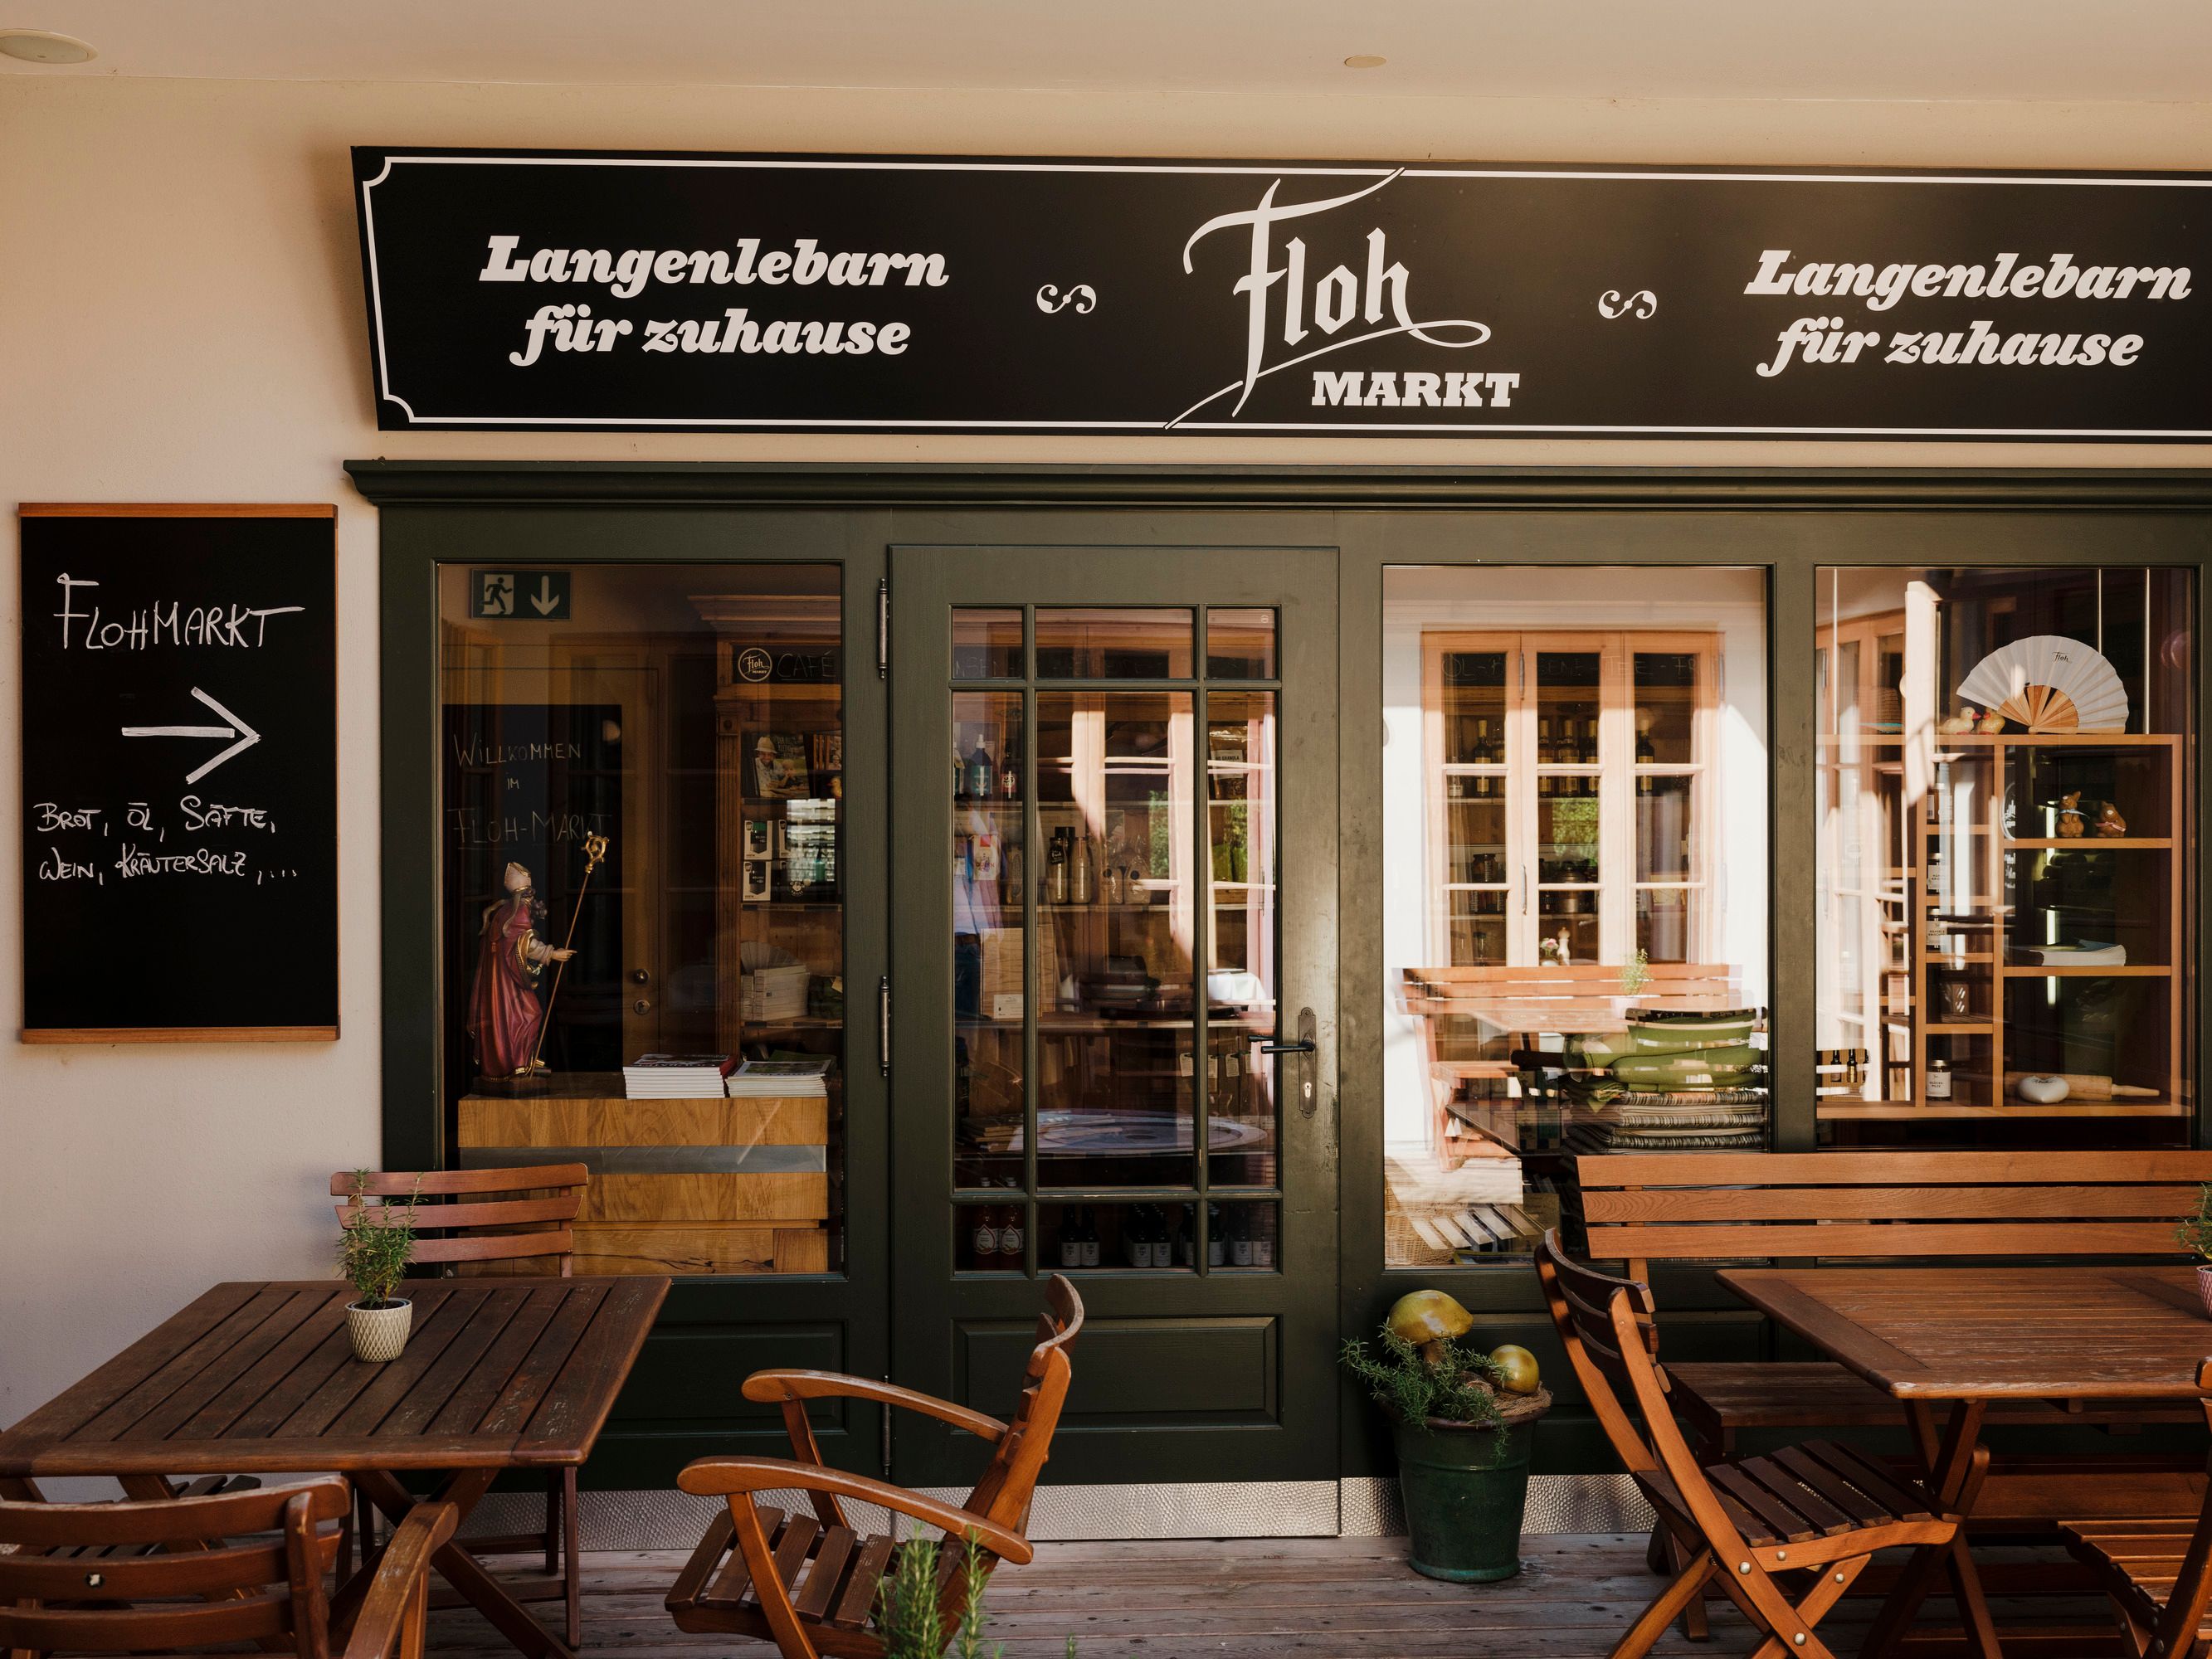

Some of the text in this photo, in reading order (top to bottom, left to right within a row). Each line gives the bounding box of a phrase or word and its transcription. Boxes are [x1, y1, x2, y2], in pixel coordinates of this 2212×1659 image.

[479, 235, 950, 299] Langenlebarn
[1182, 168, 1492, 418] Floh
[1743, 250, 2192, 312] Langenlebarn
[509, 304, 912, 367] für zuhause
[1756, 315, 2144, 377] für zuhause
[1311, 371, 1520, 407] MARKT
[53, 572, 306, 650] FLOHMARKT
[776, 649, 837, 679] CAFÉ
